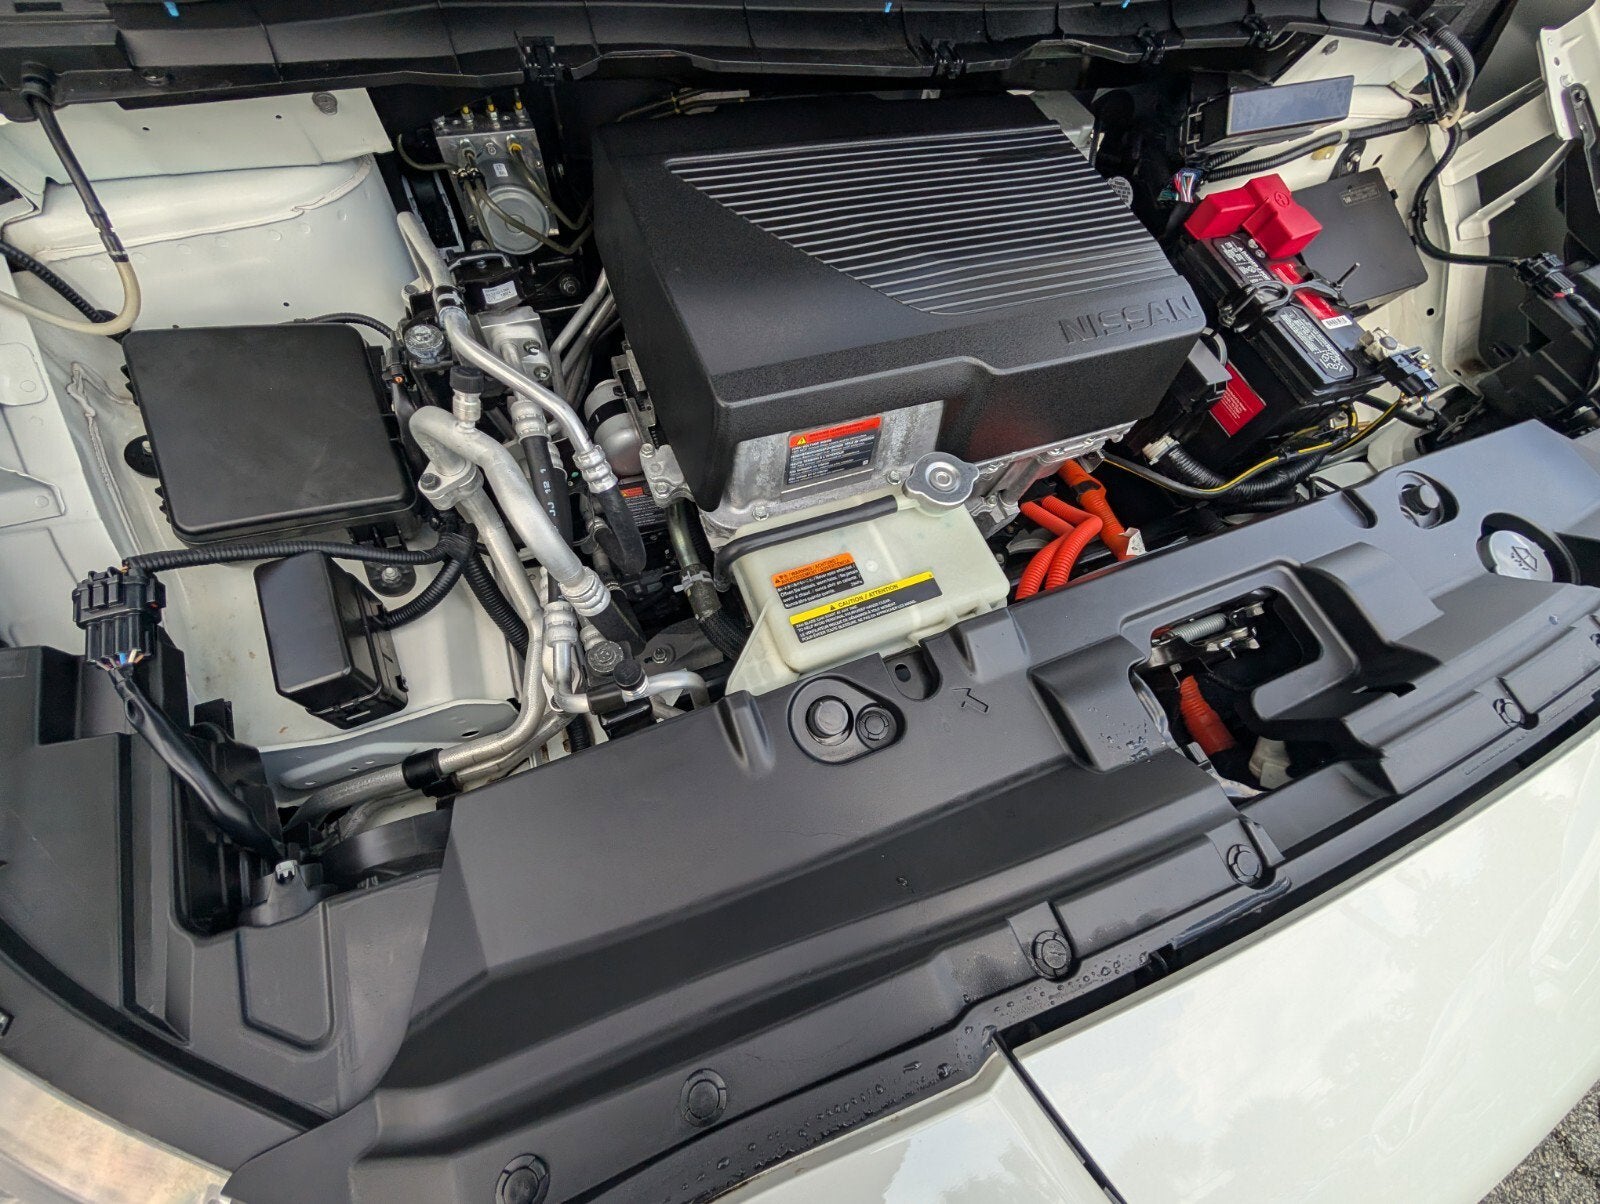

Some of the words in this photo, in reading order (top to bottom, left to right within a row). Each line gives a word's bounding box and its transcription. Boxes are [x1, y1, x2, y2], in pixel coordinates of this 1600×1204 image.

[1058, 295, 1198, 344] NISSAN
[838, 595, 864, 608] CAUTION
[868, 584, 899, 598] ATTENTION
